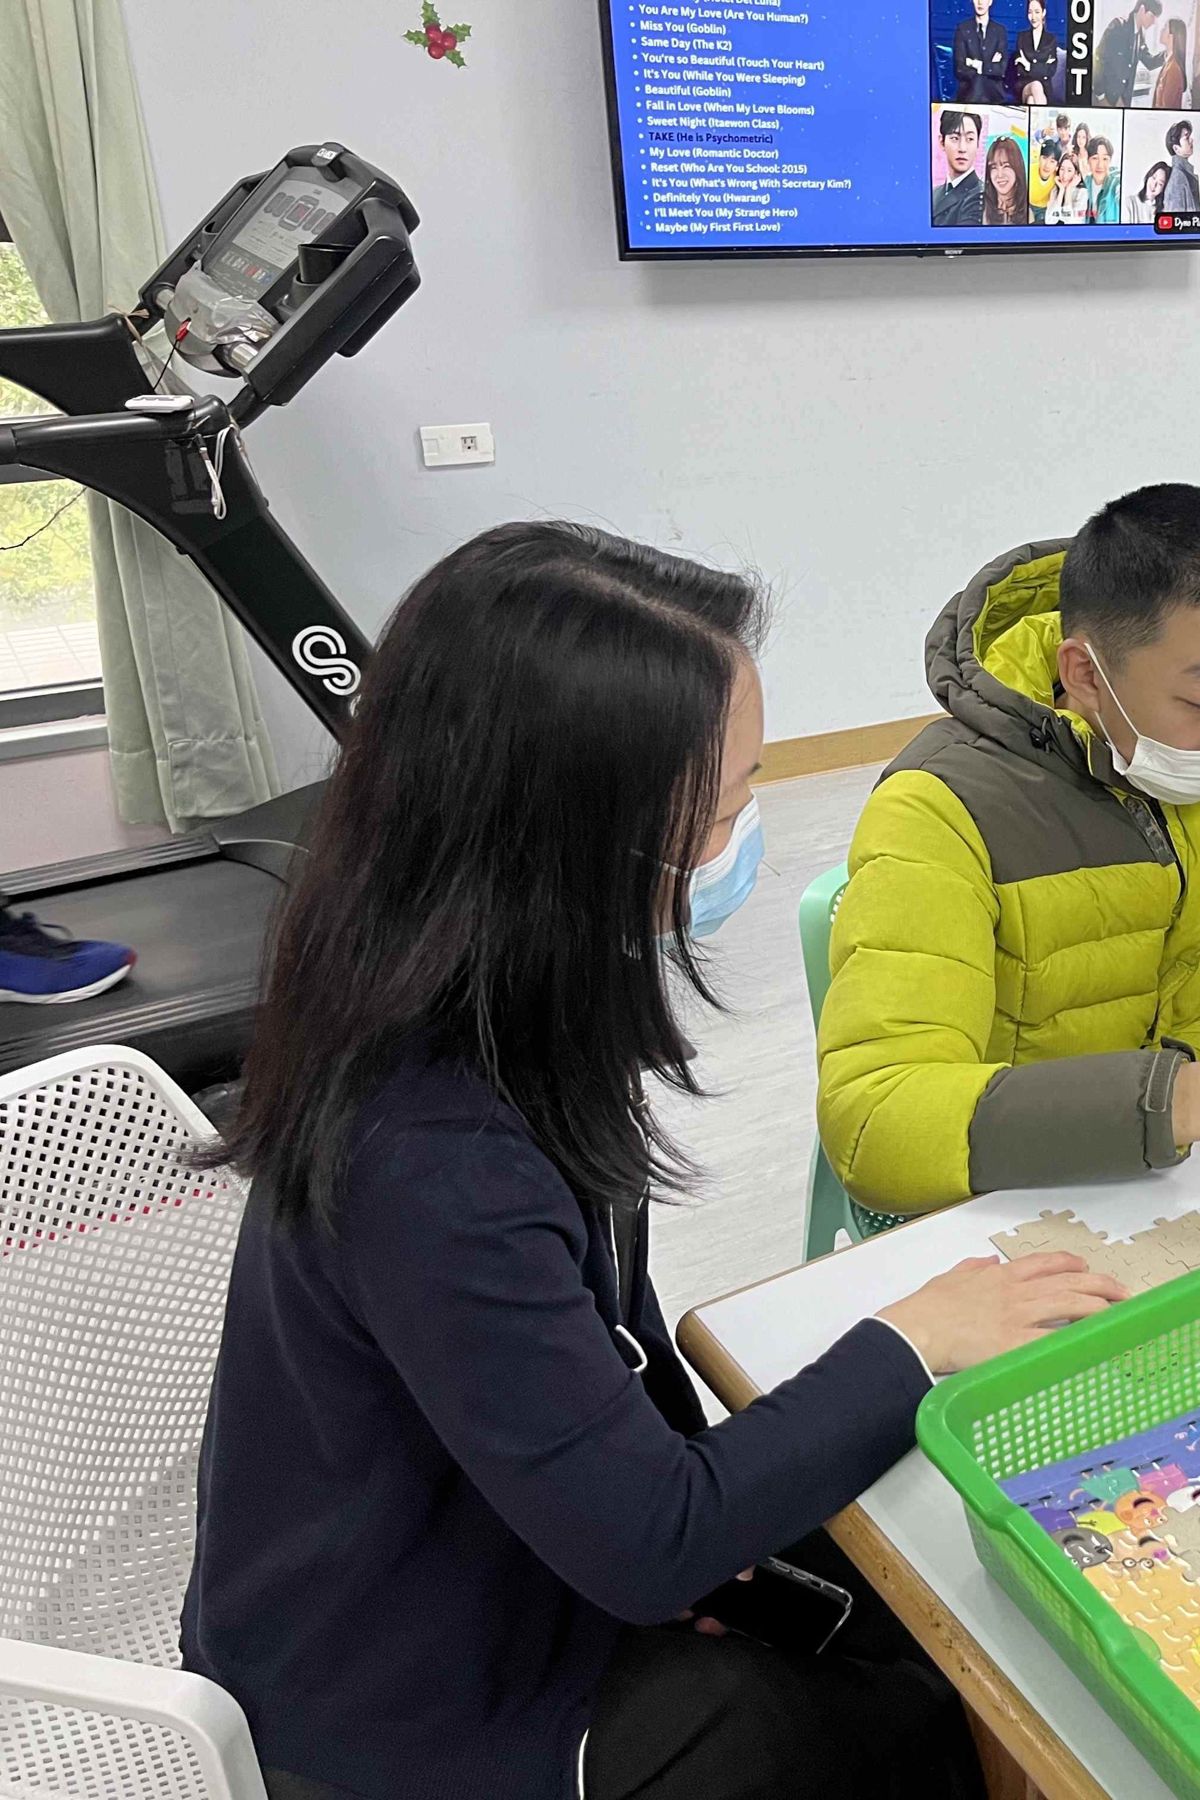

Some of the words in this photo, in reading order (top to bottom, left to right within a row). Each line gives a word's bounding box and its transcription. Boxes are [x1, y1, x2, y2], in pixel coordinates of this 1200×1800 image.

[638, 3, 659, 15] You
[660, 5, 679, 16] Are
[680, 6, 697, 20] My
[697, 7, 723, 19] Love
[723, 8, 745, 20] (Are
[745, 10, 765, 21] You
[766, 11, 809, 25] Human?)
[639, 20, 664, 32] Miss
[664, 21, 685, 33] You
[686, 22, 727, 36] (Goblin)
[640, 36, 670, 48] Same
[670, 37, 691, 51] Day
[692, 38, 715, 50] (The
[715, 40, 733, 52] K2)
[641, 52, 675, 64] You're
[676, 55, 689, 65] so
[689, 54, 736, 66] Beautiful
[736, 56, 770, 68] (Touch
[770, 58, 794, 69] Your
[794, 59, 825, 71] Heart)
[643, 68, 660, 79] It's
[660, 69, 681, 80] You
[682, 69, 715, 81] (While
[714, 71, 735, 82] You
[735, 72, 762, 83] Were
[761, 73, 806, 87] Sleeping)
[644, 83, 692, 96] Beautiful
[691, 85, 732, 98] (Goblin)
[645, 99, 665, 111] Fall
[665, 100, 677, 111] in
[677, 101, 702, 112] Love
[703, 101, 735, 113] (When
[735, 103, 751, 116] My
[752, 103, 776, 114] Love
[776, 104, 815, 116] Blooms)
[646, 115, 679, 127] Sweet
[678, 116, 707, 130] Night
[707, 117, 751, 128] (Itaewon
[751, 118, 780, 130] Class)
[648, 131, 675, 142] TAKE
[676, 131, 694, 143] (He
[695, 132, 704, 142] is
[705, 132, 774, 145] Psychometric)
[649, 146, 665, 160] My
[666, 147, 691, 158] Love
[692, 147, 742, 159] (Romantic
[742, 148, 779, 160] Doctor)
[650, 161, 679, 173] Reset
[679, 162, 706, 173] (Who
[707, 162, 725, 173] Are
[725, 163, 745, 173] You
[745, 163, 781, 174] School:
[781, 163, 808, 175] 2015)
[651, 177, 668, 188] It's
[668, 177, 689, 188] You
[689, 177, 727, 189] (What's
[726, 178, 759, 191] Wrong
[758, 178, 781, 188] With
[781, 178, 826, 191] Secretary
[826, 179, 852, 190] Kim?)
[652, 191, 702, 205] Definitely
[701, 193, 722, 203] You
[722, 192, 771, 205] (Hwarang)
[654, 207, 667, 217] I'll
[668, 207, 694, 218] Meet
[694, 207, 714, 218] You
[714, 207, 734, 219] (My
[734, 207, 771, 220] Strange
[771, 207, 798, 218] Hero)
[655, 222, 689, 235] Maybe
[689, 222, 709, 234] (My
[709, 222, 732, 232] First
[732, 221, 754, 232] First
[755, 222, 781, 232] Love)
